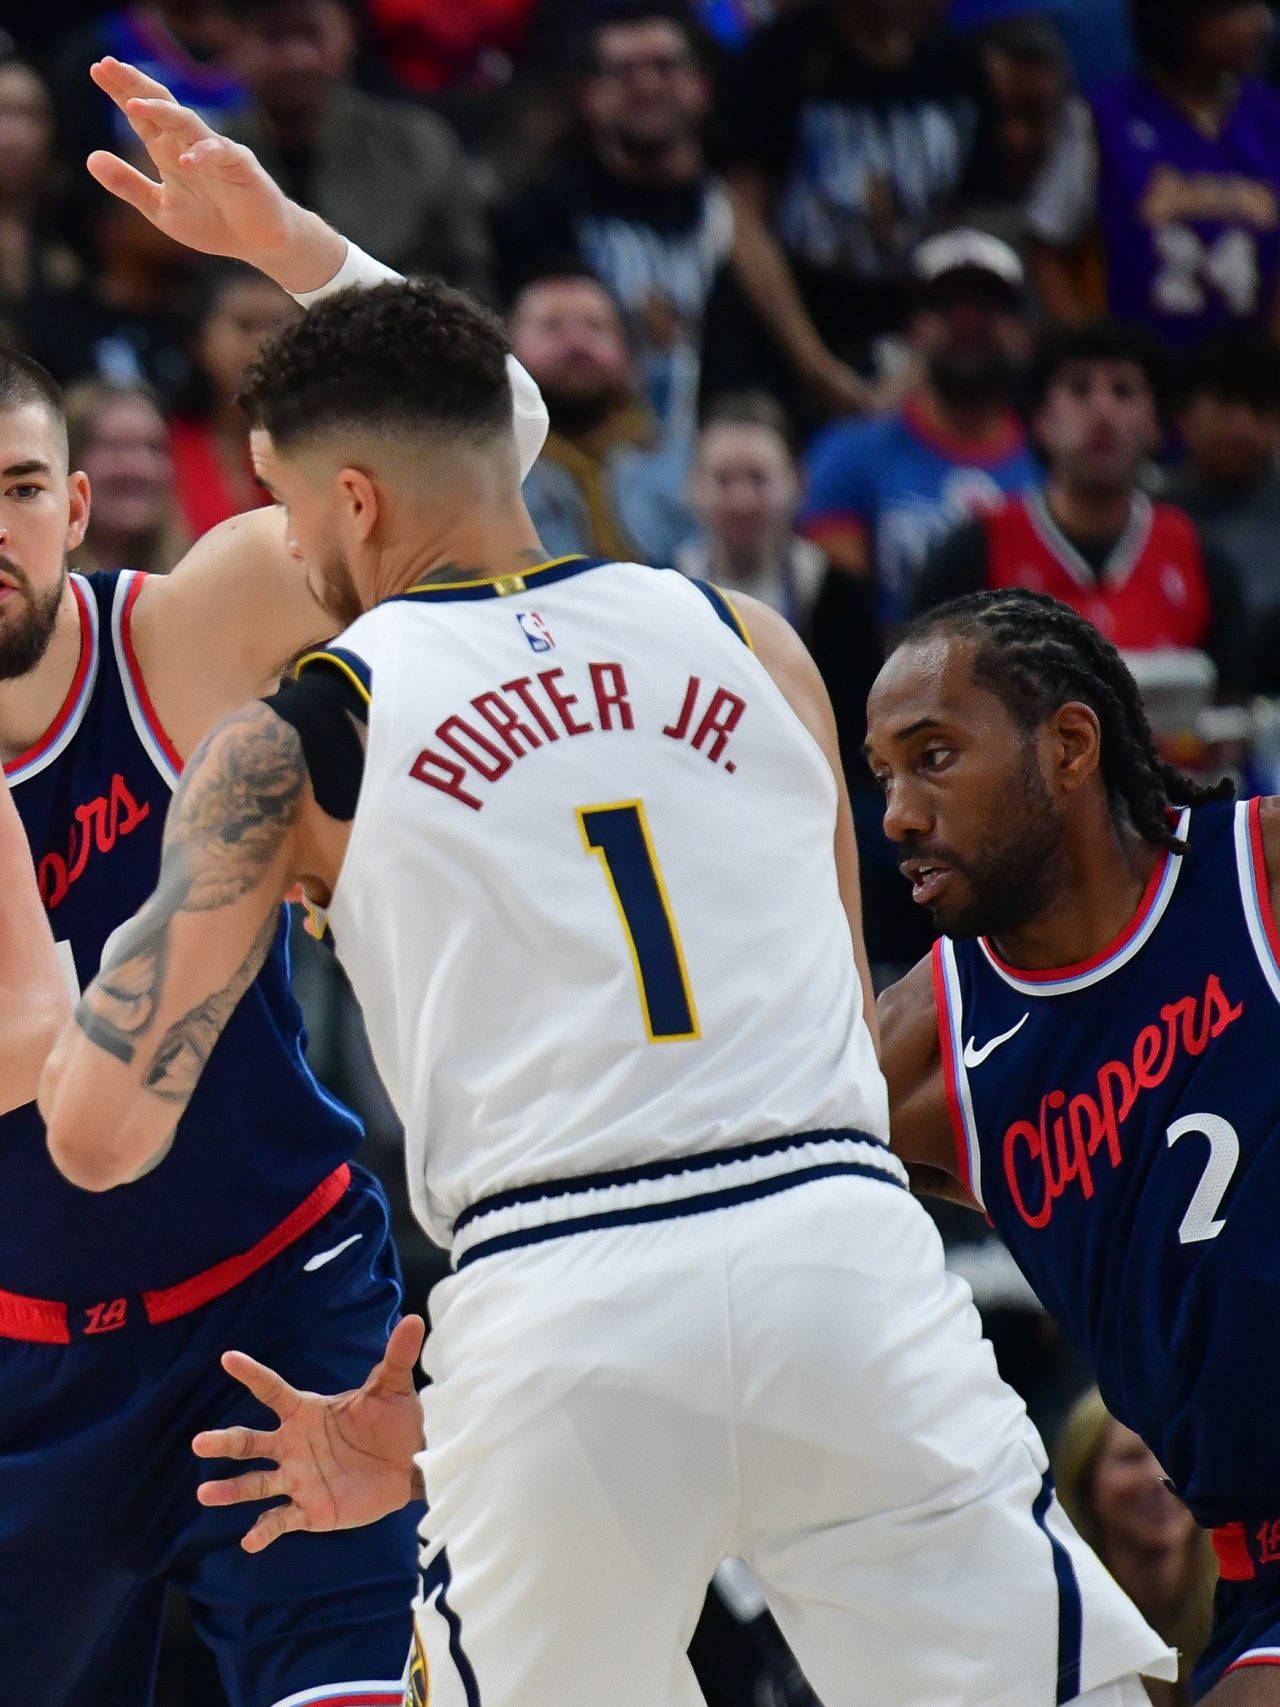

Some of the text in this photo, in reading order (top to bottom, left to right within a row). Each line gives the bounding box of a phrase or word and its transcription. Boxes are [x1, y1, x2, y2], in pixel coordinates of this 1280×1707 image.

[409, 662, 747, 811] PORTER JR.
[574, 798, 702, 1044] 1
[1002, 973, 1246, 1229] Clippers
[1166, 1112, 1241, 1244] 2
